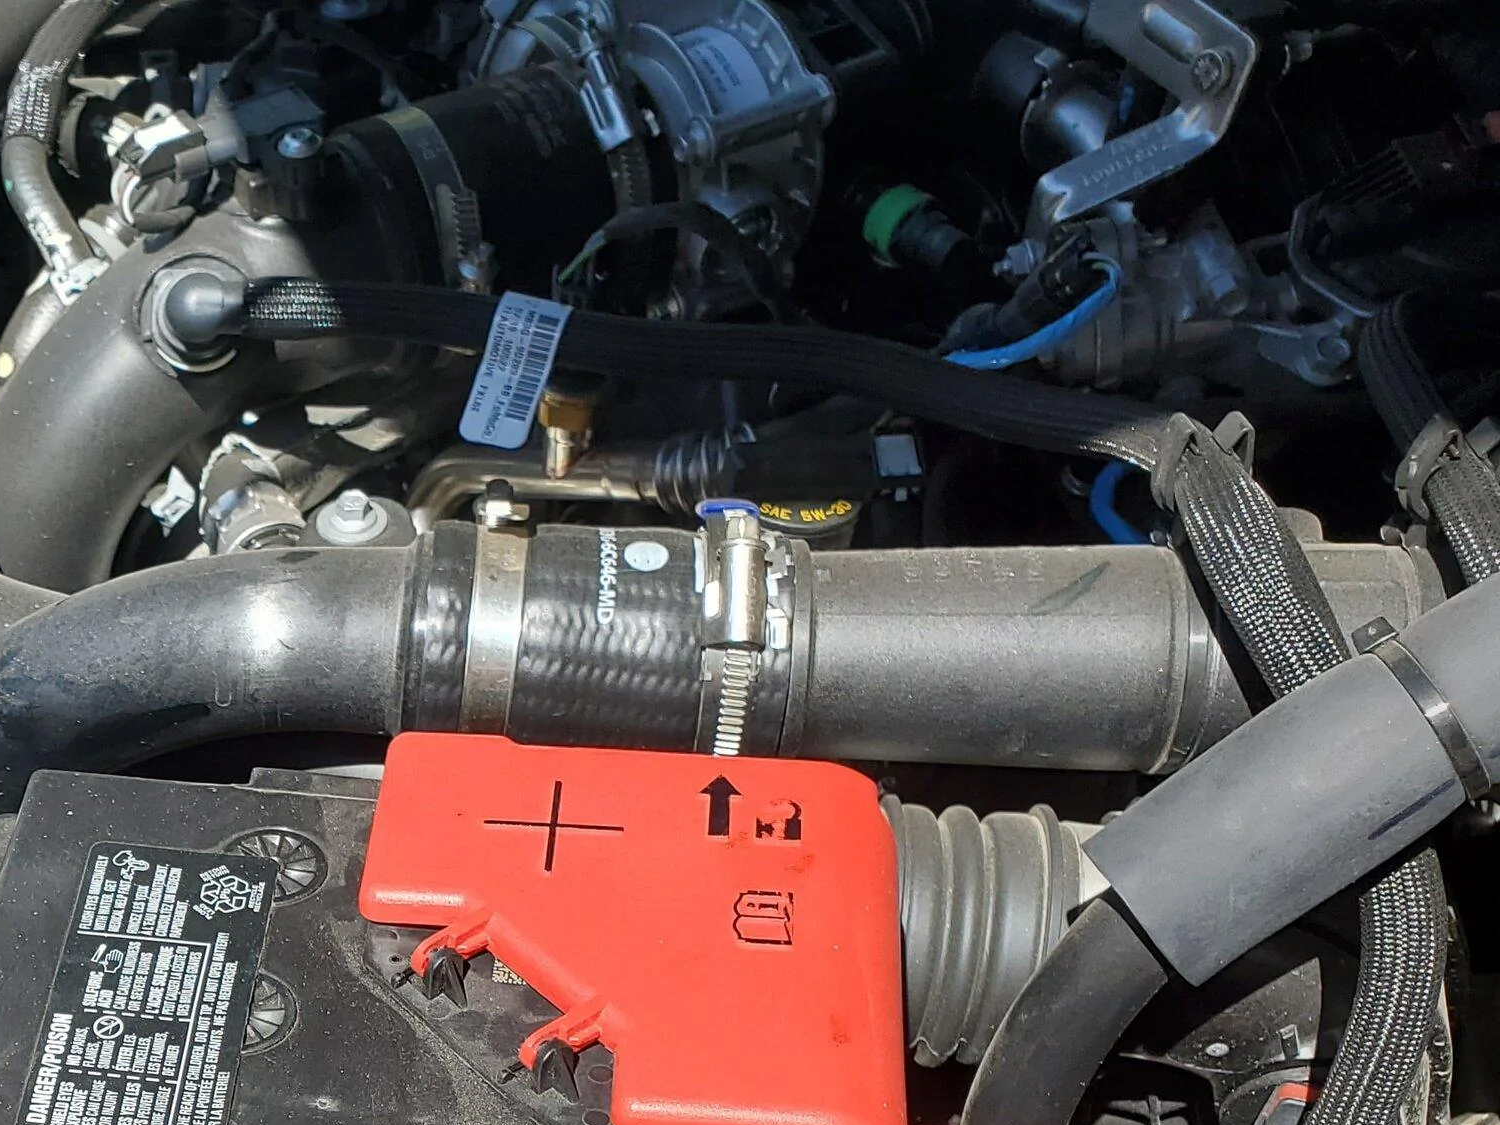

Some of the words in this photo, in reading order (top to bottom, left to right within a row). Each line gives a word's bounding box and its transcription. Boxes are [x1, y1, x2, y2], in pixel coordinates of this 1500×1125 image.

[759, 502, 792, 520] SAE
[102, 878, 117, 892] GET
[133, 884, 150, 901] YEUX
[218, 887, 232, 900] Pb
[83, 894, 99, 910] EYES
[96, 892, 114, 915] WATER.
[113, 893, 128, 909] HELP
[131, 900, 146, 913] LES
[78, 909, 95, 930] FLUSH
[154, 902, 174, 937] CONSULTEZ
[175, 945, 189, 954] OU
[211, 931, 230, 962] BATTERY!
[169, 971, 183, 980] LA
[207, 961, 223, 978] OPEN
[81, 970, 104, 1007] SULFURIC
[115, 974, 133, 996] CAUSE
[129, 974, 147, 1000] SEVERE
[204, 977, 219, 992] NOT
[217, 960, 238, 1000] RENVERSER.
[96, 988, 114, 1008] ACID
[112, 995, 127, 1010] CAN
[144, 985, 164, 1014] L'ACIDE
[202, 991, 216, 1002] DO
[126, 1000, 141, 1011] OR
[175, 1003, 190, 1016] DES
[198, 1002, 214, 1015] TIP.
[214, 1000, 230, 1015] PAS
[196, 1015, 211, 1031] NOT
[212, 1014, 226, 1026] NE
[69, 1026, 90, 1054] SPARKS,
[194, 1031, 208, 1043] DO
[204, 1026, 224, 1063] ENFANTS.
[81, 1040, 102, 1068] FLAMES,
[96, 1039, 115, 1069] SMOKING
[110, 1045, 134, 1072] ÉVITER
[122, 1033, 137, 1046] LES
[129, 1035, 153, 1073] ÉTINCELLES,
[148, 1030, 169, 1062] FLAMMES,
[25, 1012, 73, 1124] DANGER/POISON
[65, 1053, 82, 1066] NO
[146, 1061, 161, 1075] LES
[185, 1043, 206, 1080] CHILDREN.
[161, 1066, 175, 1076] DE
[201, 1063, 217, 1079] DES
[56, 1080, 75, 1102] EYES
[88, 1078, 106, 1102] CAUSE
[124, 1081, 141, 1096] LES
[183, 1079, 199, 1091] OF
[193, 1078, 214, 1108] PORTÉE
[210, 1071, 230, 1108] BATTERIE!
[84, 1101, 100, 1116] CAN
[100, 1089, 118, 1116] INJURY
[119, 1095, 138, 1115] YEUX
[136, 1089, 154, 1119] PEUVENT
[178, 1090, 196, 1115] REACH
[193, 1108, 208, 1119] LA
[208, 1108, 223, 1120] LA
